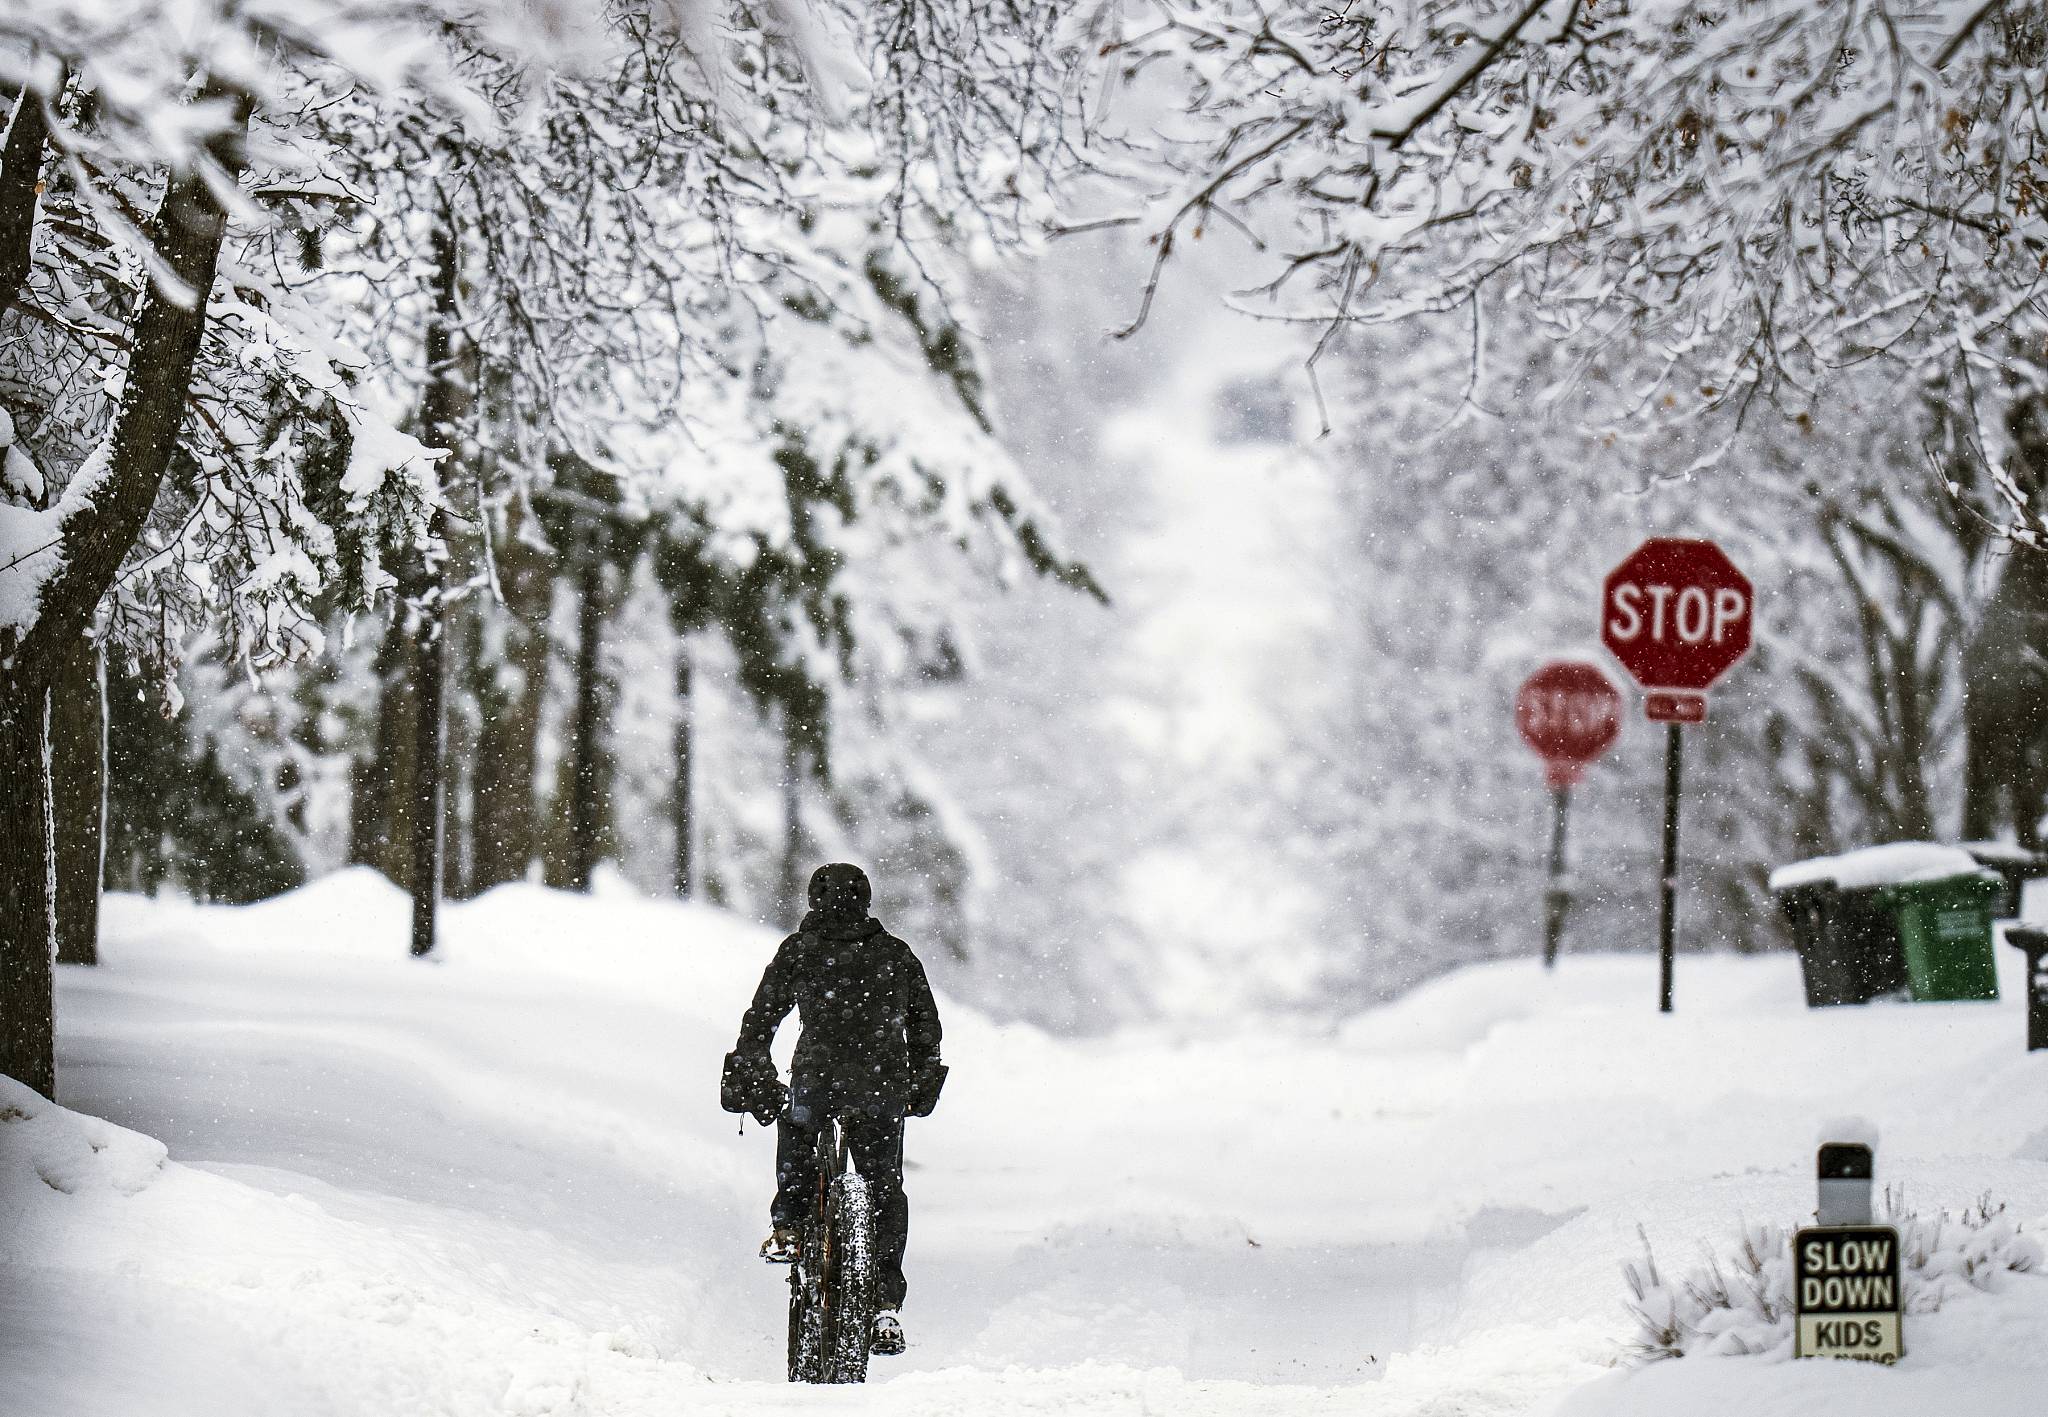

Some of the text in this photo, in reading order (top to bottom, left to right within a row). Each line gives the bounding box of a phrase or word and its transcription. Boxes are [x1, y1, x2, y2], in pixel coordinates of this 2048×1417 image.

[1609, 583, 1745, 644] STOP
[1803, 1241, 1890, 1273] SLOW
[1803, 1276, 1893, 1309] DOWN
[1815, 1320, 1883, 1349] KIDS
